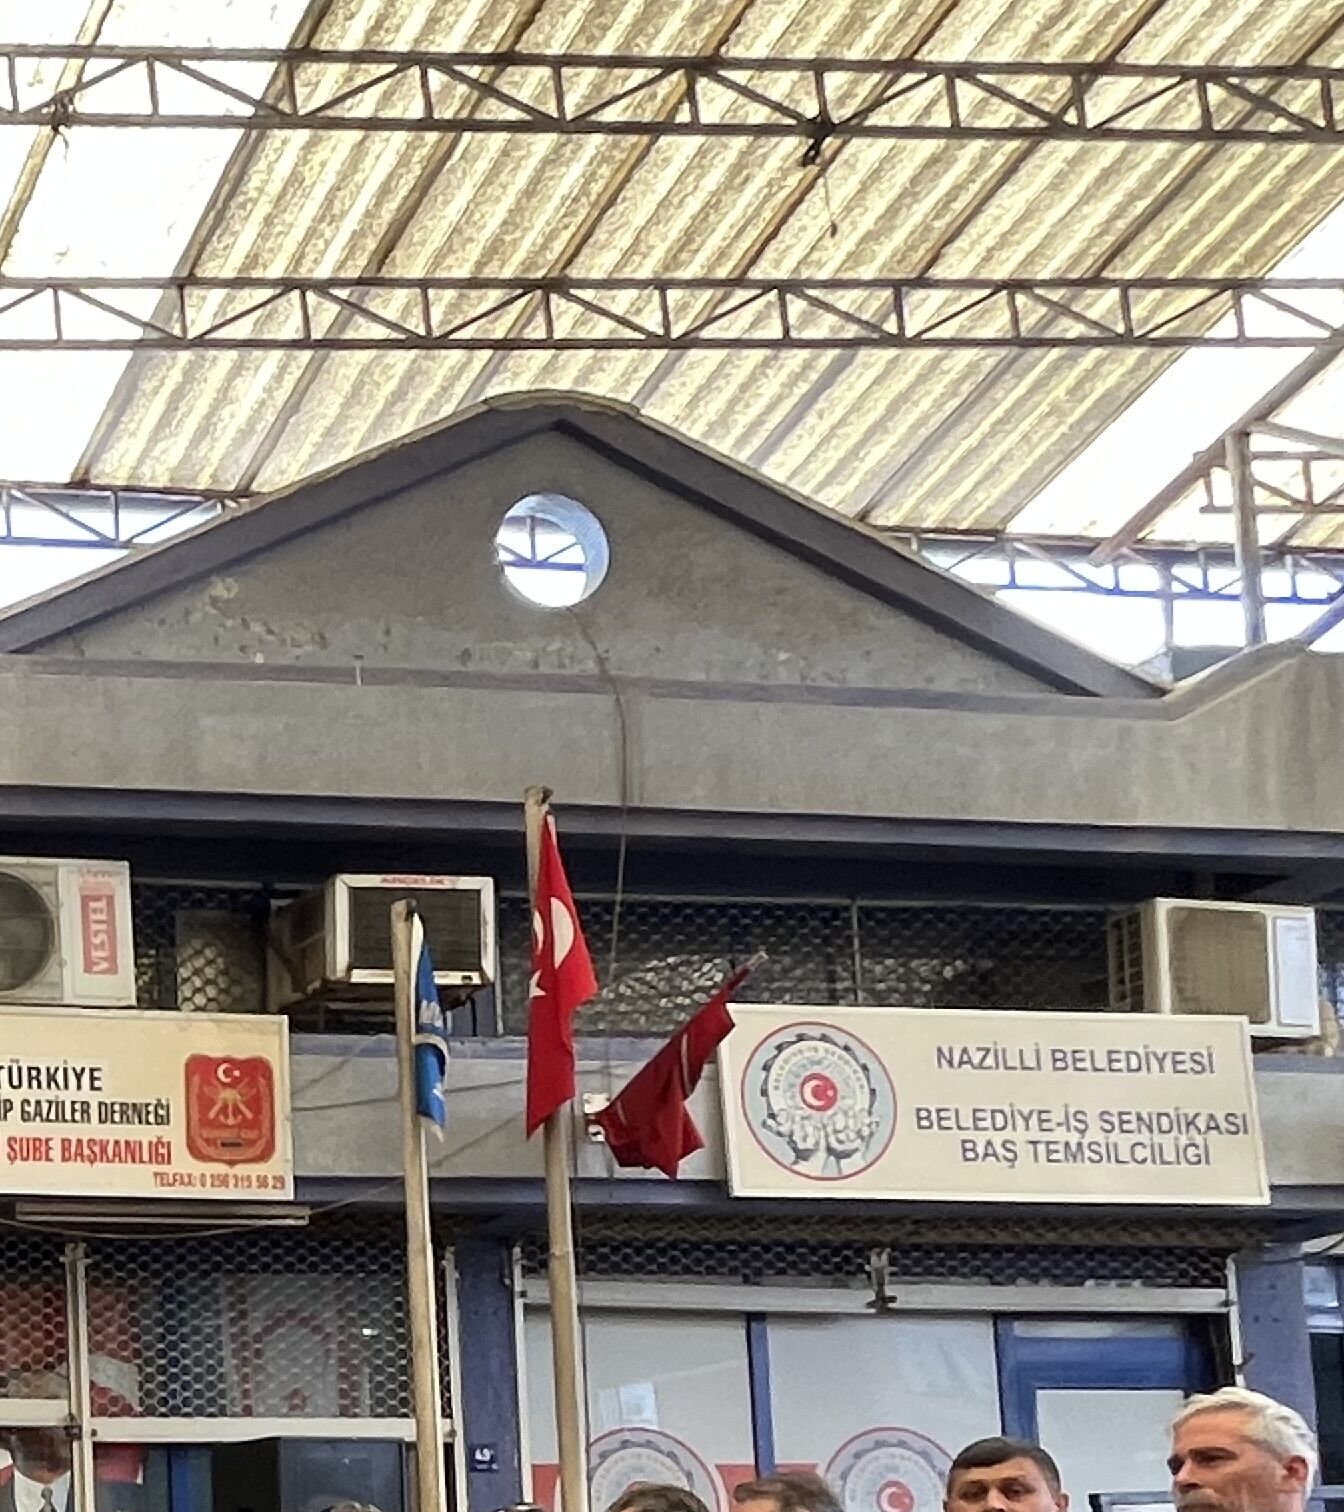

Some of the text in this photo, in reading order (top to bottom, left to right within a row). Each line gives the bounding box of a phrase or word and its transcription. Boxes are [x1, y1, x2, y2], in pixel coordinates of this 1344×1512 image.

[936, 1041, 1216, 1075] NAZİLLİ BELEDİYESİ
[20, 1095, 91, 1124] GAZİLER
[97, 1097, 171, 1126] DERNEĞİ
[1098, 1107, 1249, 1136] SENDİKASI
[6, 1136, 54, 1165] ŞUBE
[60, 1135, 172, 1168] BAŞKANLIĞI
[961, 1139, 1018, 1169] BAŞ
